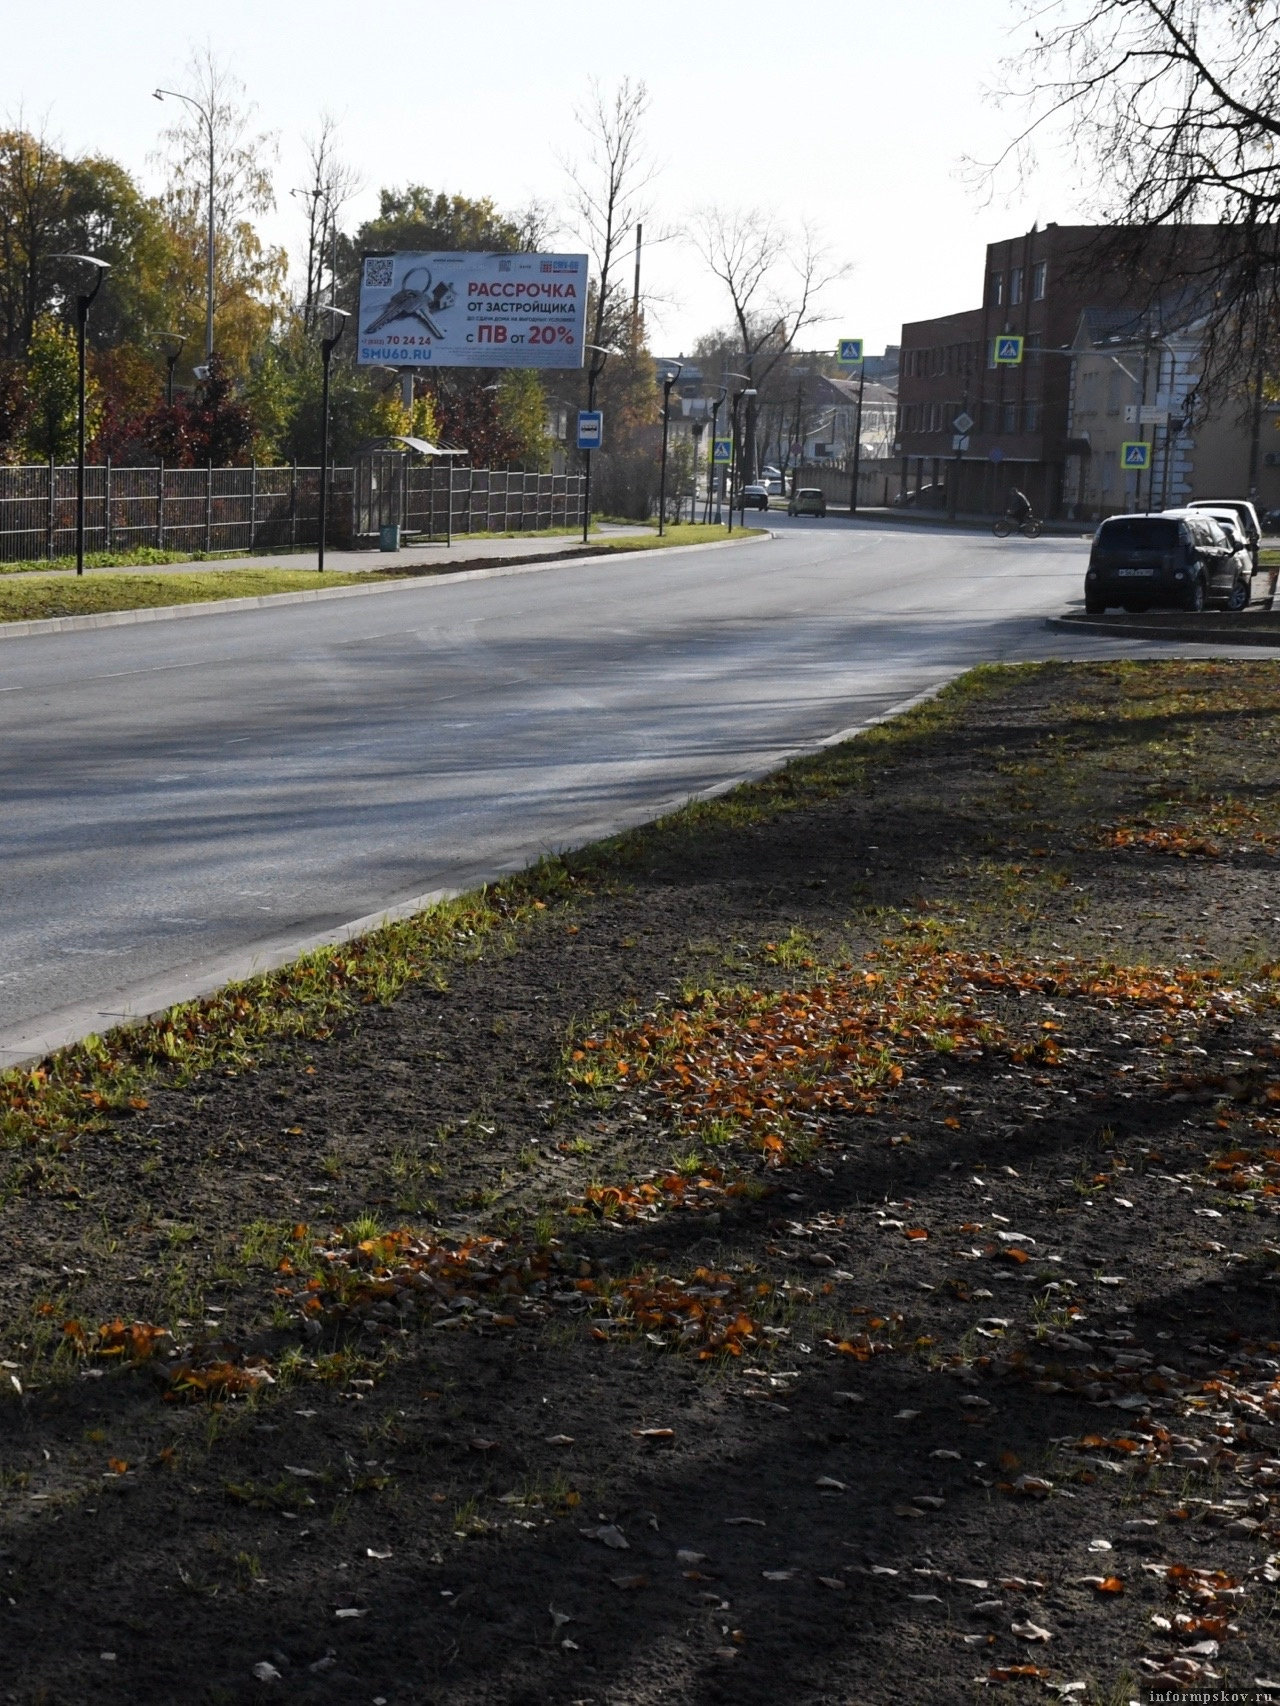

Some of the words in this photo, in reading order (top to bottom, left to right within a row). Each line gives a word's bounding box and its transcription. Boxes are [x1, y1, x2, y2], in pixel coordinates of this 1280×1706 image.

[468, 282, 576, 298] РАССРОЧКА
[467, 302, 483, 312] ОТ
[486, 301, 576, 314] ЗАСТРОЙЩИКА
[386, 336, 400, 345] 70
[402, 336, 416, 345] 24
[418, 336, 432, 345] 24
[477, 325, 507, 343] ПВ
[528, 325, 575, 344] 20%
[361, 348, 432, 360] SMU60.RU
